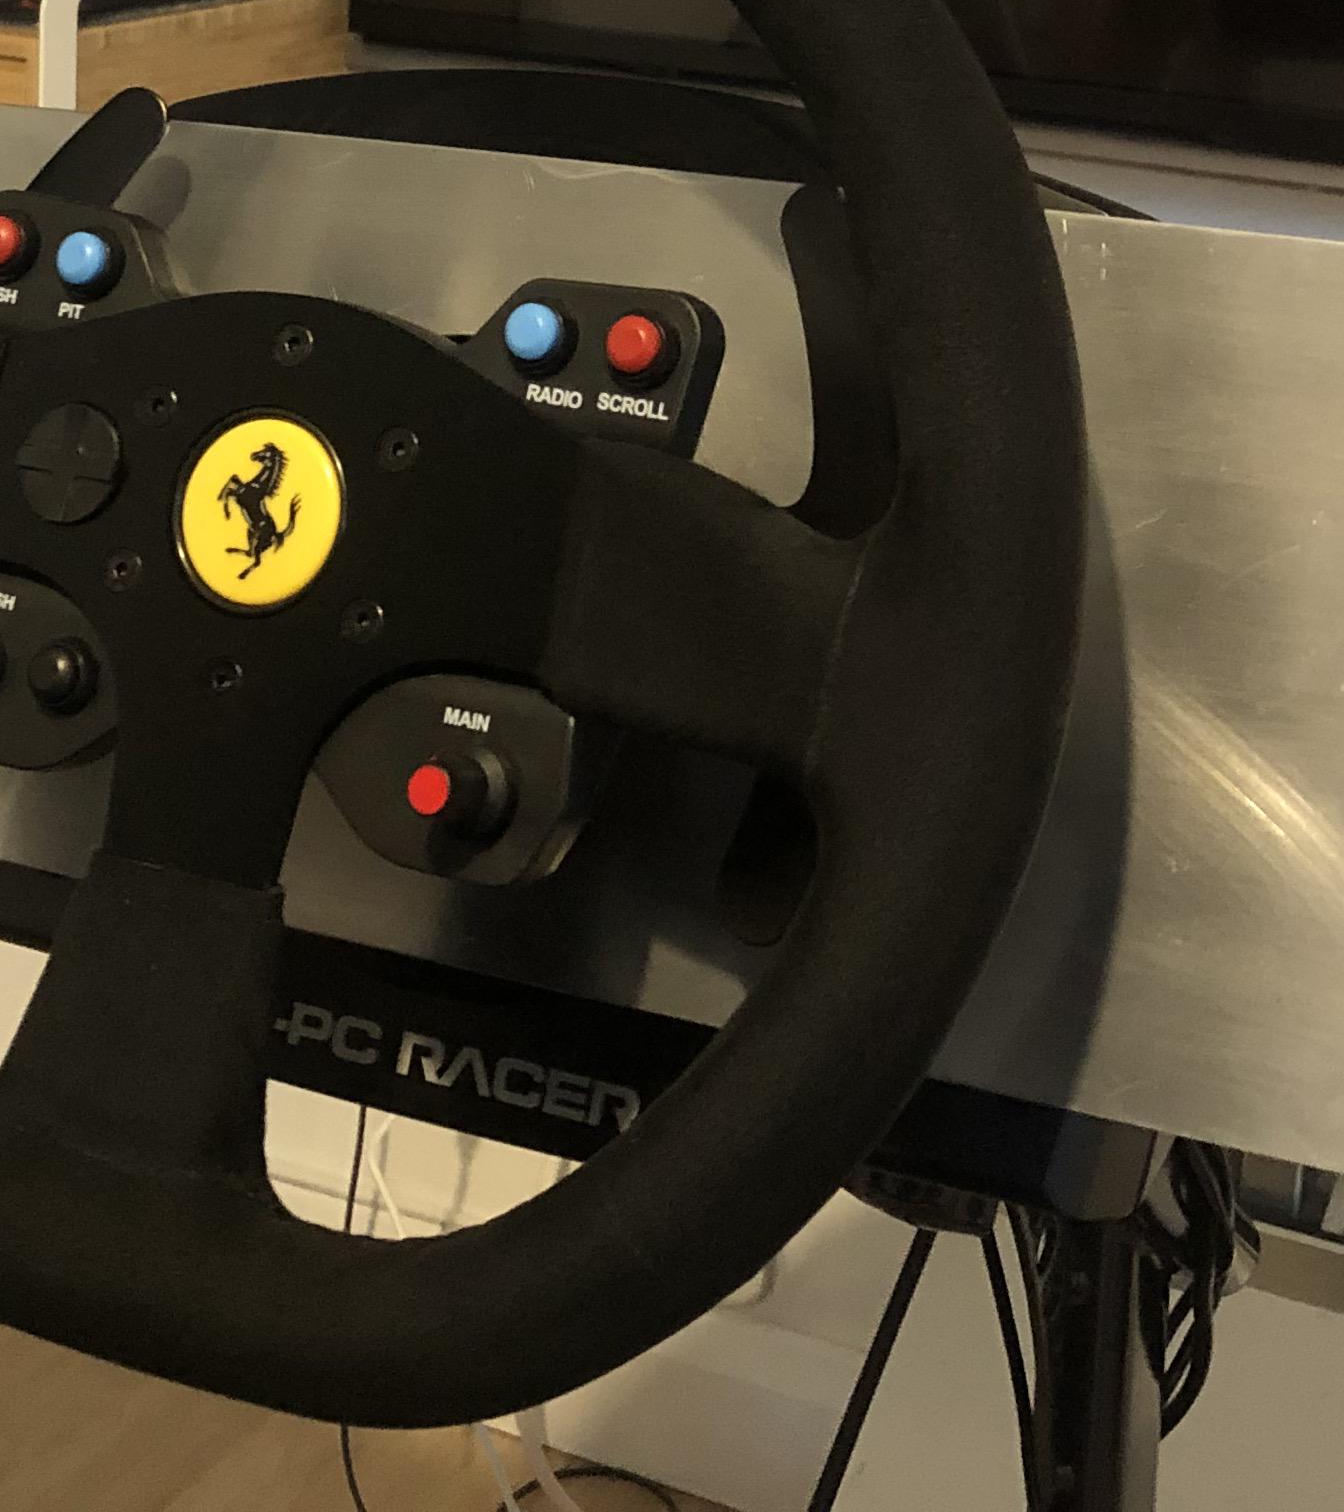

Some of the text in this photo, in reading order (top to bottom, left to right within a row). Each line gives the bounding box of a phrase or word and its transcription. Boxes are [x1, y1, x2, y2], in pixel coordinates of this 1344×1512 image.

[57, 301, 86, 320] PIT
[525, 382, 670, 422] RADIO SCROLL
[442, 705, 492, 734] MAIN
[394, 1029, 642, 1134] RACER
